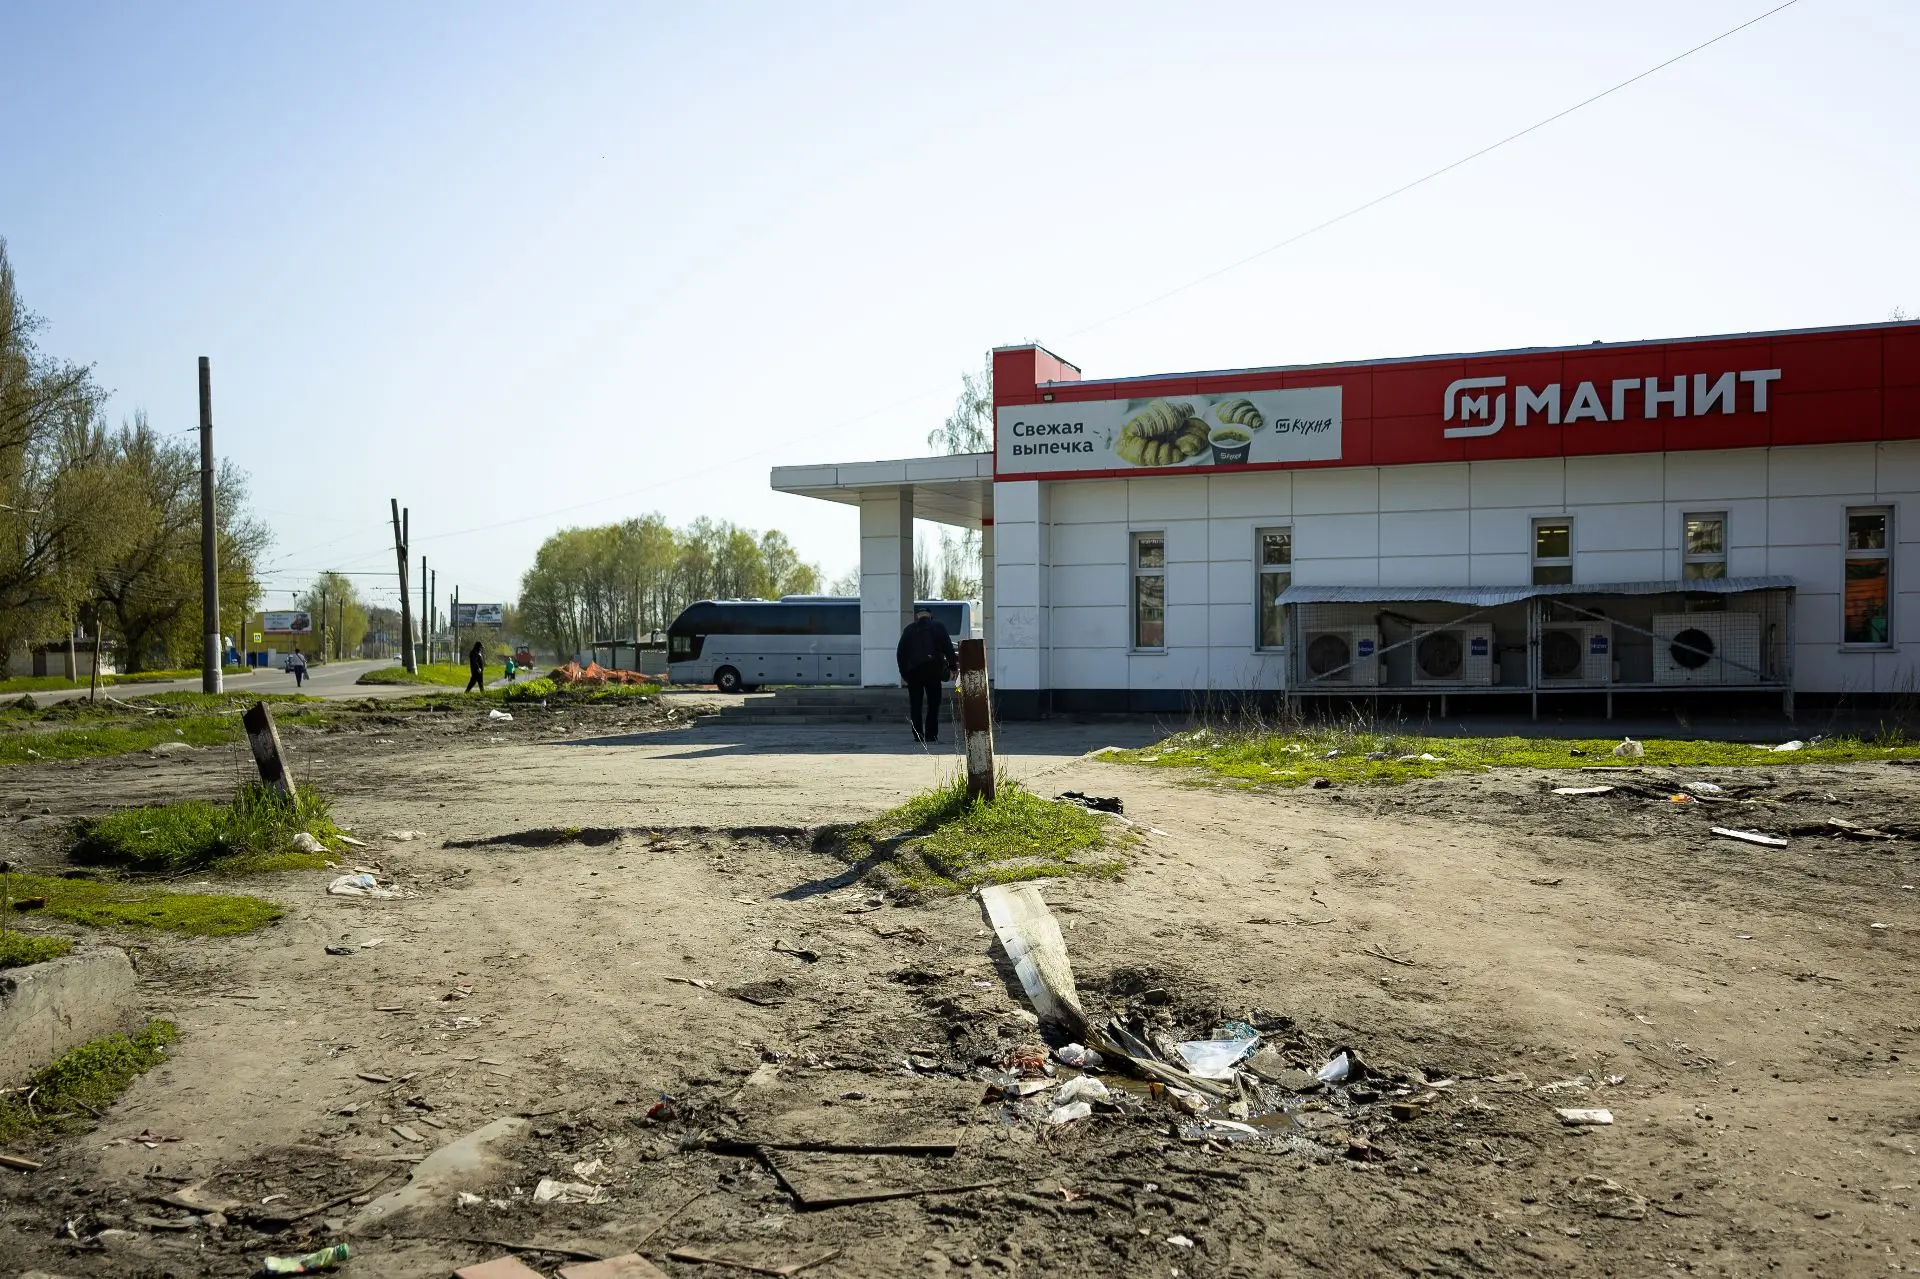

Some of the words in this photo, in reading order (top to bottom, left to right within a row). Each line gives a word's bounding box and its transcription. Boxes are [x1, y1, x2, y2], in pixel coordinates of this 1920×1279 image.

[1515, 368, 1782, 426] МАГНИТ
[1012, 421, 1084, 437] Свежая
[1012, 440, 1094, 456] выпечка
